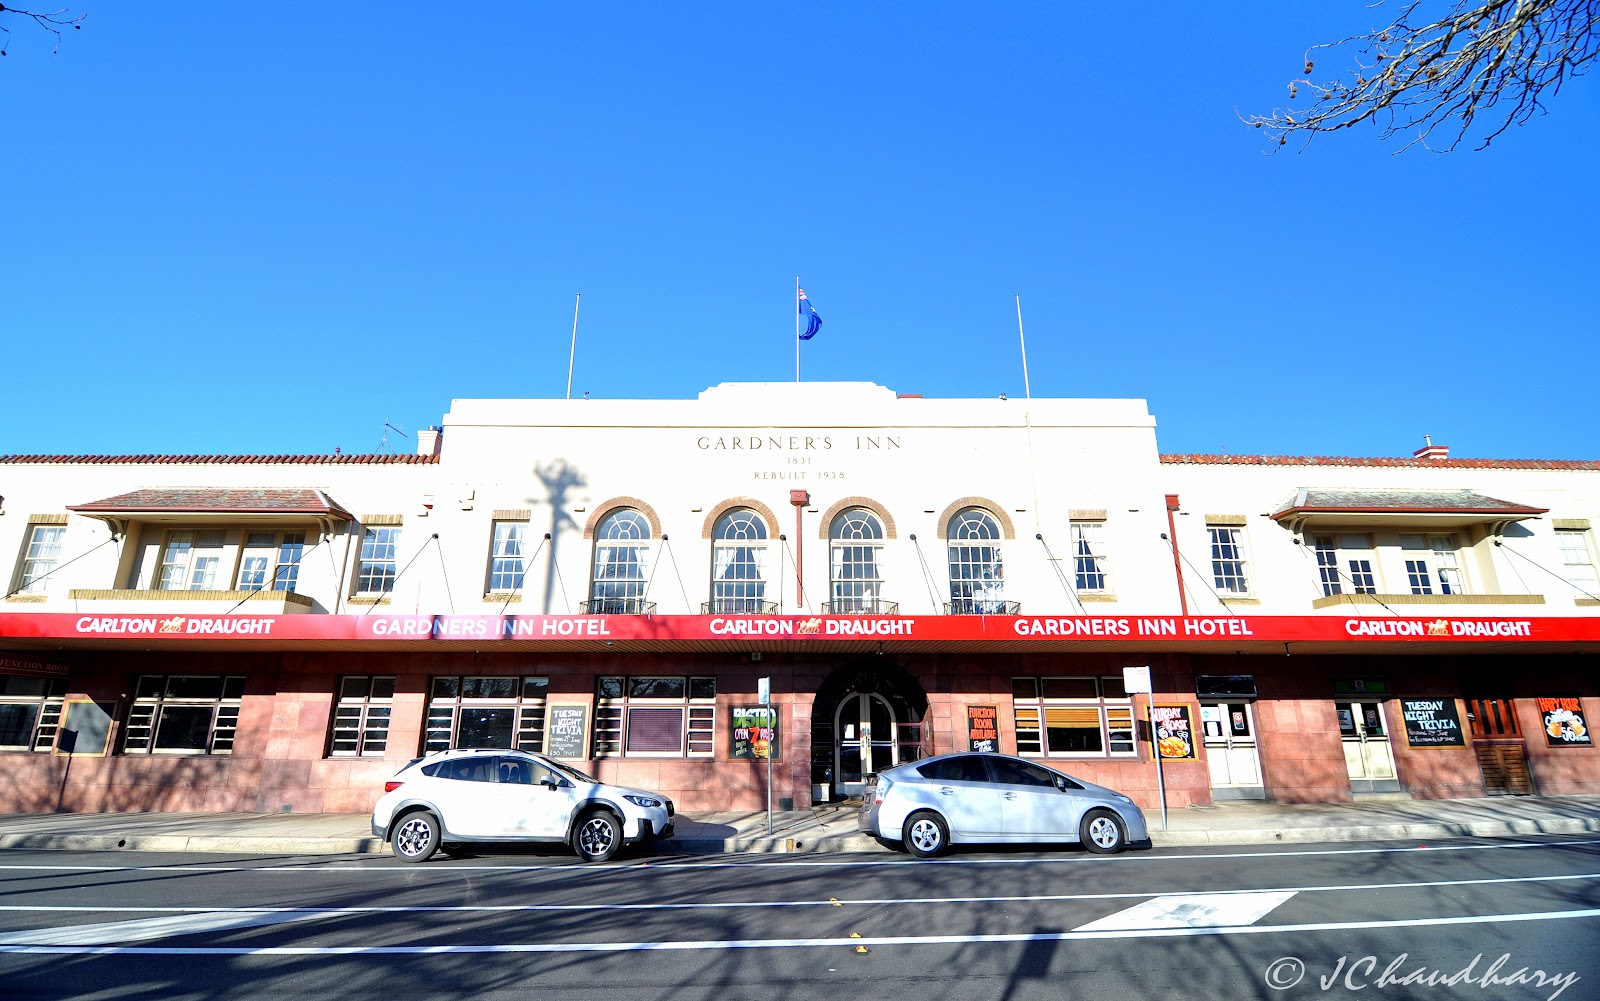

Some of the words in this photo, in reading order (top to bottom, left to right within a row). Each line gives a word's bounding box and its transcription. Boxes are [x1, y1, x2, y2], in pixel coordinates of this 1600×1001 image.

[697, 436, 832, 450] GARDNER'S
[856, 436, 901, 450] INN
[787, 457, 811, 465] 1831
[754, 471, 807, 480] REBUILT
[818, 471, 845, 479] 1938
[76, 616, 157, 633] CARLTON
[186, 619, 275, 634] DRAUGHT
[372, 619, 488, 635] GARDNERS
[495, 620, 534, 635] INN
[542, 620, 611, 635] HOTEL
[709, 618, 793, 635] CARLTON
[825, 619, 915, 635] DRAUGHT
[1014, 618, 1130, 636] GARDNERS
[1137, 619, 1177, 636] INN
[1184, 619, 1253, 636] HOTEL
[1345, 619, 1424, 637] CARLTON
[1451, 621, 1531, 637] DRAUGHT
[0, 659, 44, 670] FUNCTION
[45, 663, 70, 672] ROOM
[1405, 701, 1443, 711] TUESDAY
[553, 710, 583, 718] TUESDAY
[733, 708, 777, 729] BISTRO
[968, 707, 996, 719] FUNCTION
[1404, 711, 1435, 721] NIGHT
[557, 718, 582, 727] NIGHT
[973, 719, 993, 729] ROOM
[1417, 719, 1457, 730] TRIVIA
[550, 725, 582, 735] TRIVIA
[734, 728, 749, 740] OPEN
[748, 726, 760, 744] 7
[760, 728, 775, 741] DAS
